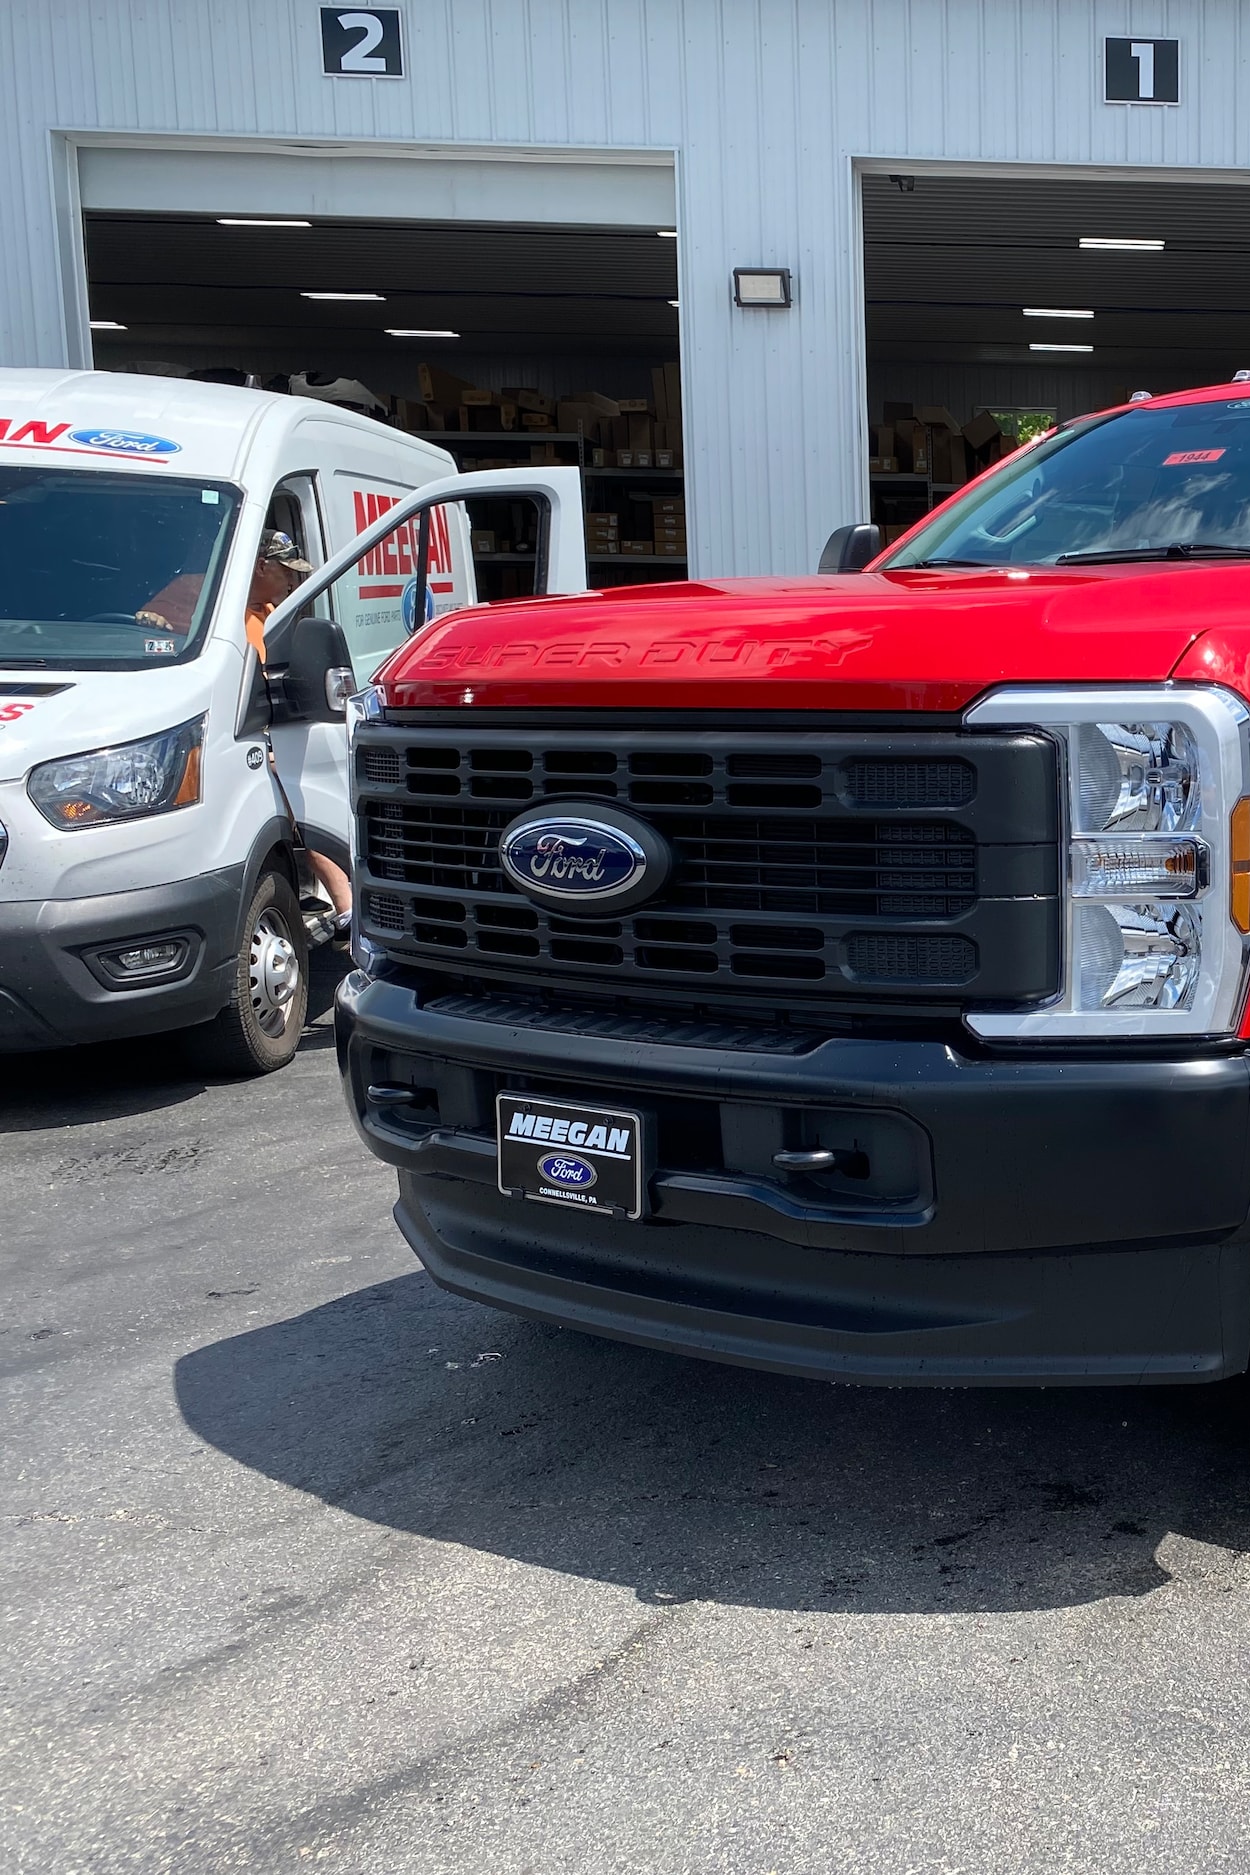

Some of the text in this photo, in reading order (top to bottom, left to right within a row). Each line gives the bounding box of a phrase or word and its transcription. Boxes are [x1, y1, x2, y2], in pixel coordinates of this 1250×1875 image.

[337, 12, 386, 71] 2
[1131, 42, 1154, 98] 1
[89, 430, 160, 453] Ford
[419, 638, 874, 671] SUPER DUTY
[530, 833, 608, 881] Ford
[509, 1112, 630, 1153] MEEGAN
[551, 1158, 583, 1181] Ford
[539, 1187, 598, 1205] CONNELLSVILLE, PA
